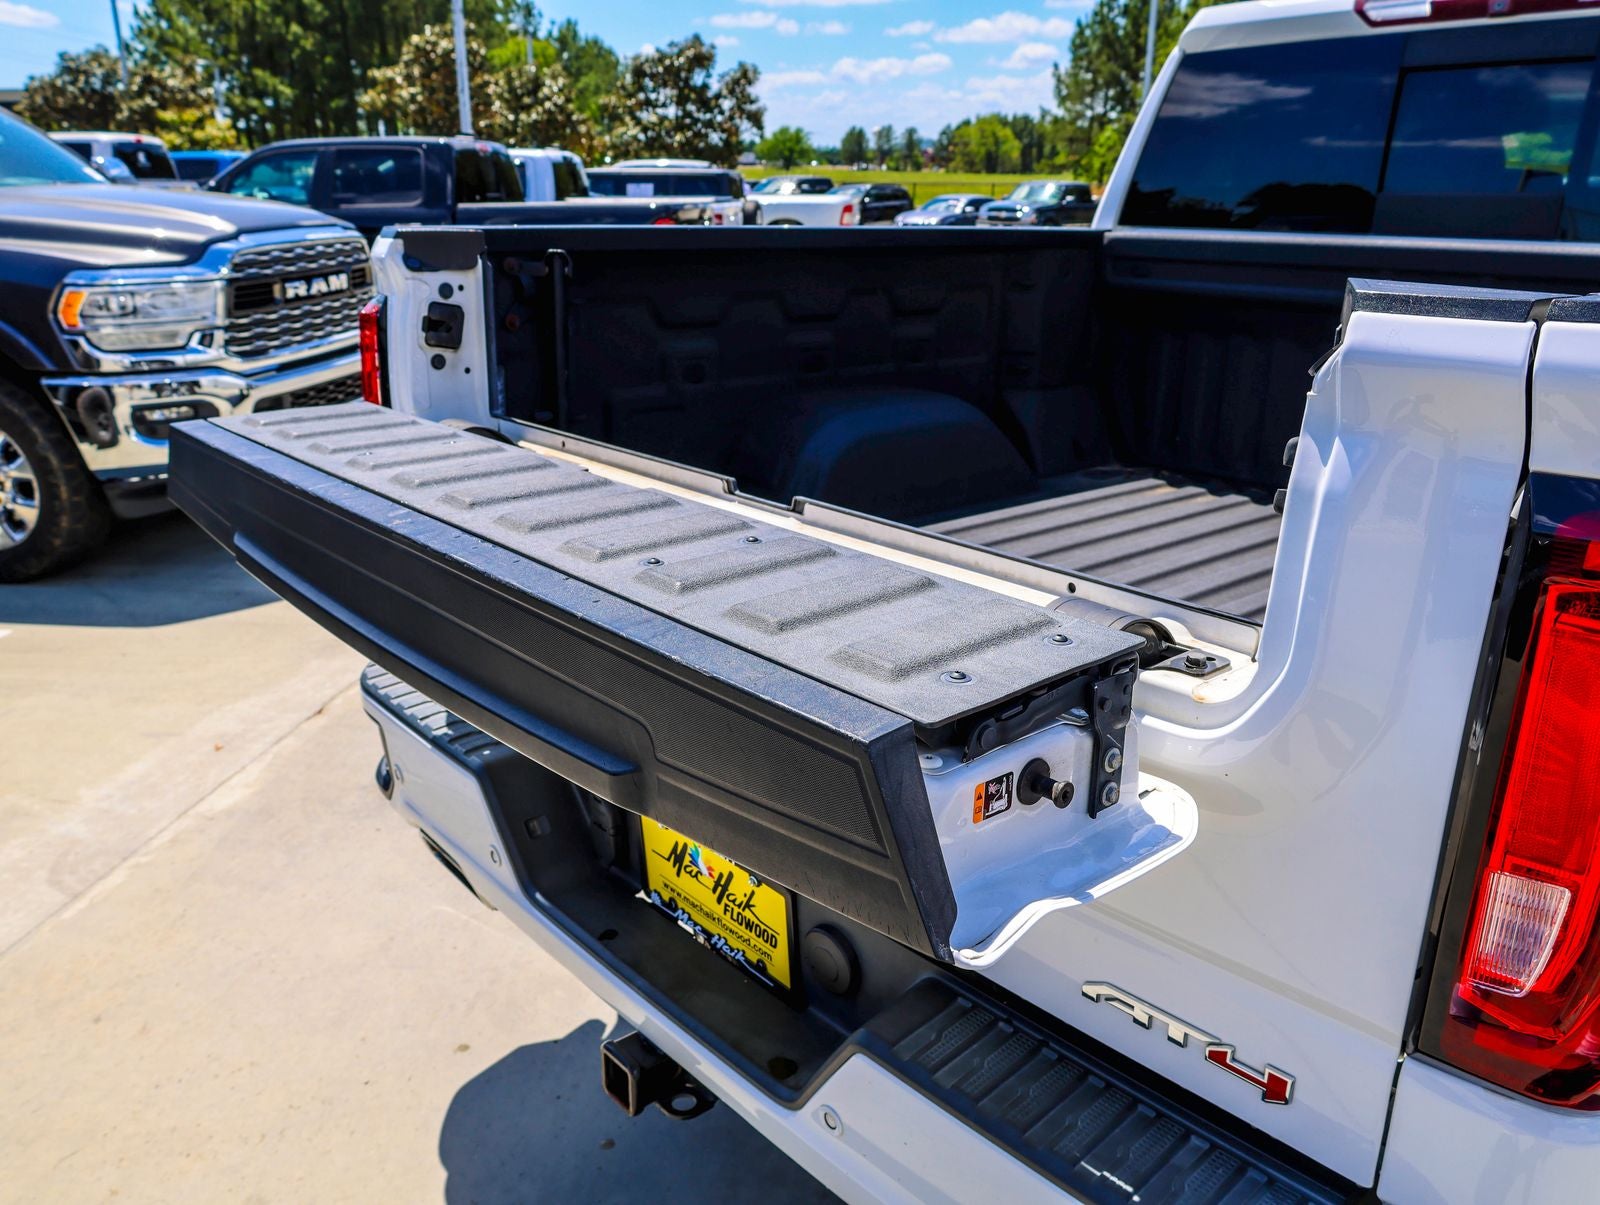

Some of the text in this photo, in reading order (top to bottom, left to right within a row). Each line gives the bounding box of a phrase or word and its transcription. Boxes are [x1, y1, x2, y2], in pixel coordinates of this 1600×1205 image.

[284, 272, 348, 299] RAM
[652, 841, 763, 921] Mac Haik
[663, 883, 773, 962] www.machaikflowood.com
[711, 934, 748, 964] Haik
[724, 903, 778, 949] FLOWOOD
[1081, 980, 1295, 1105] AT4
